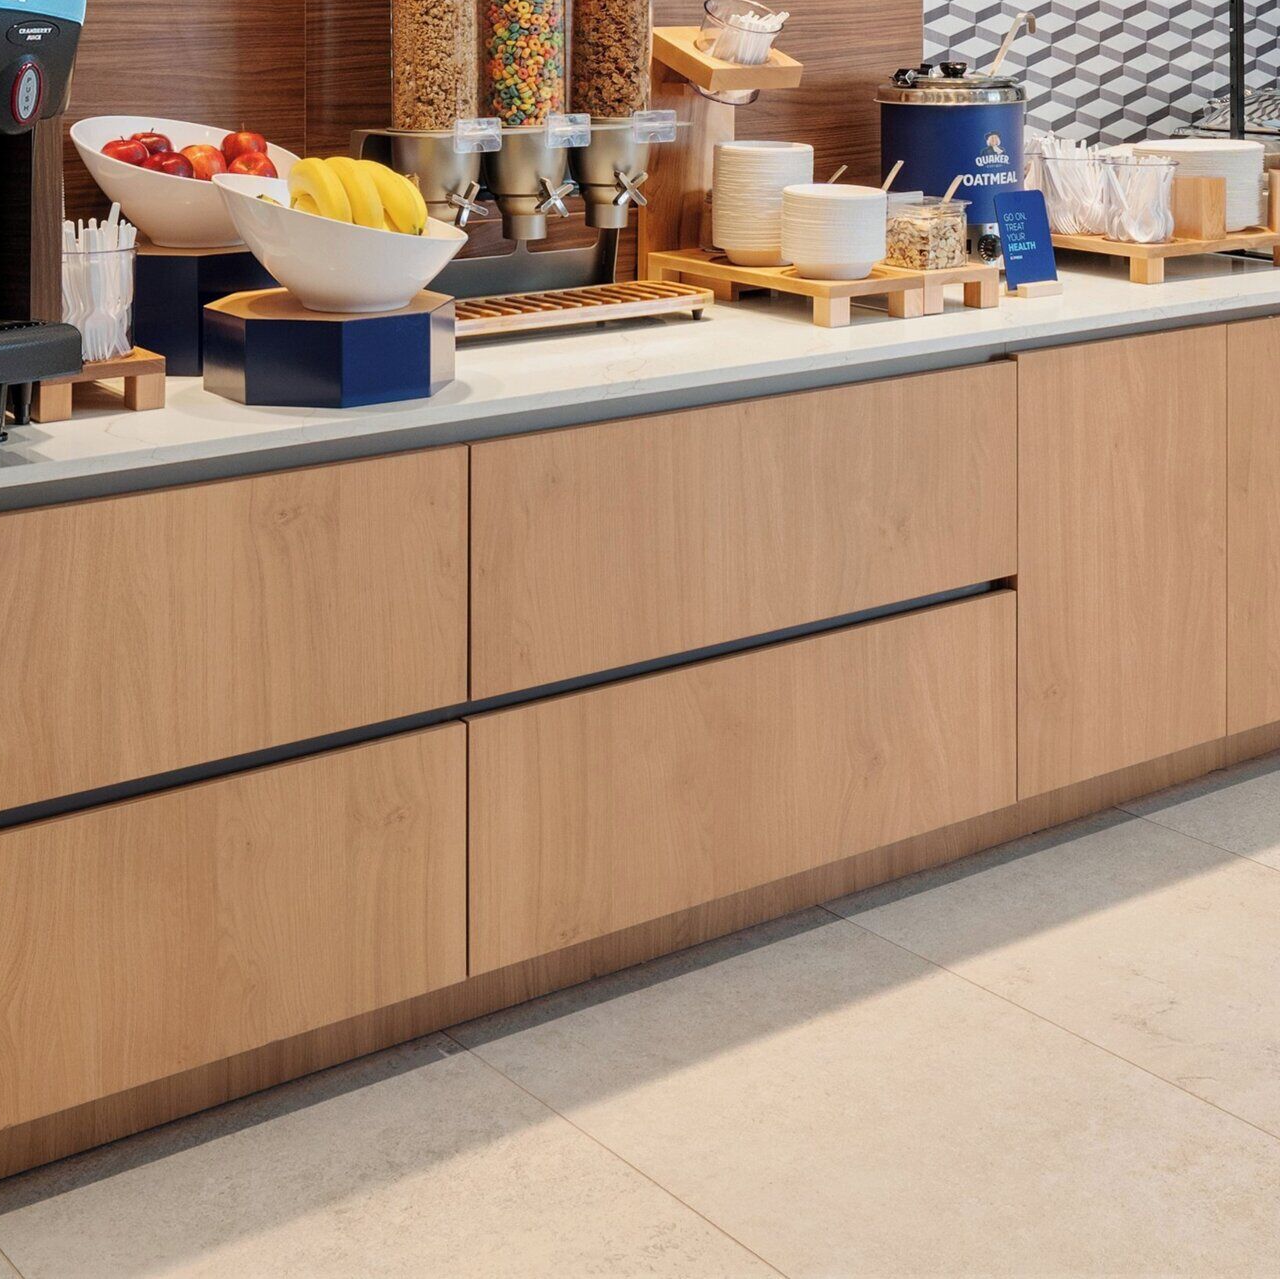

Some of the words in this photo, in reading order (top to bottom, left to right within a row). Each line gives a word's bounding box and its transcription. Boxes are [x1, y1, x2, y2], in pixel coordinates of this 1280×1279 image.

[23, 77, 34, 112] PUSH
[975, 154, 1010, 167] QUAKER
[962, 170, 1018, 187] OATMEAL
[1003, 213, 1014, 222] GO
[1005, 222, 1025, 232] TREAT
[1007, 232, 1026, 242] YOUR
[1008, 241, 1037, 252] HEALTH
